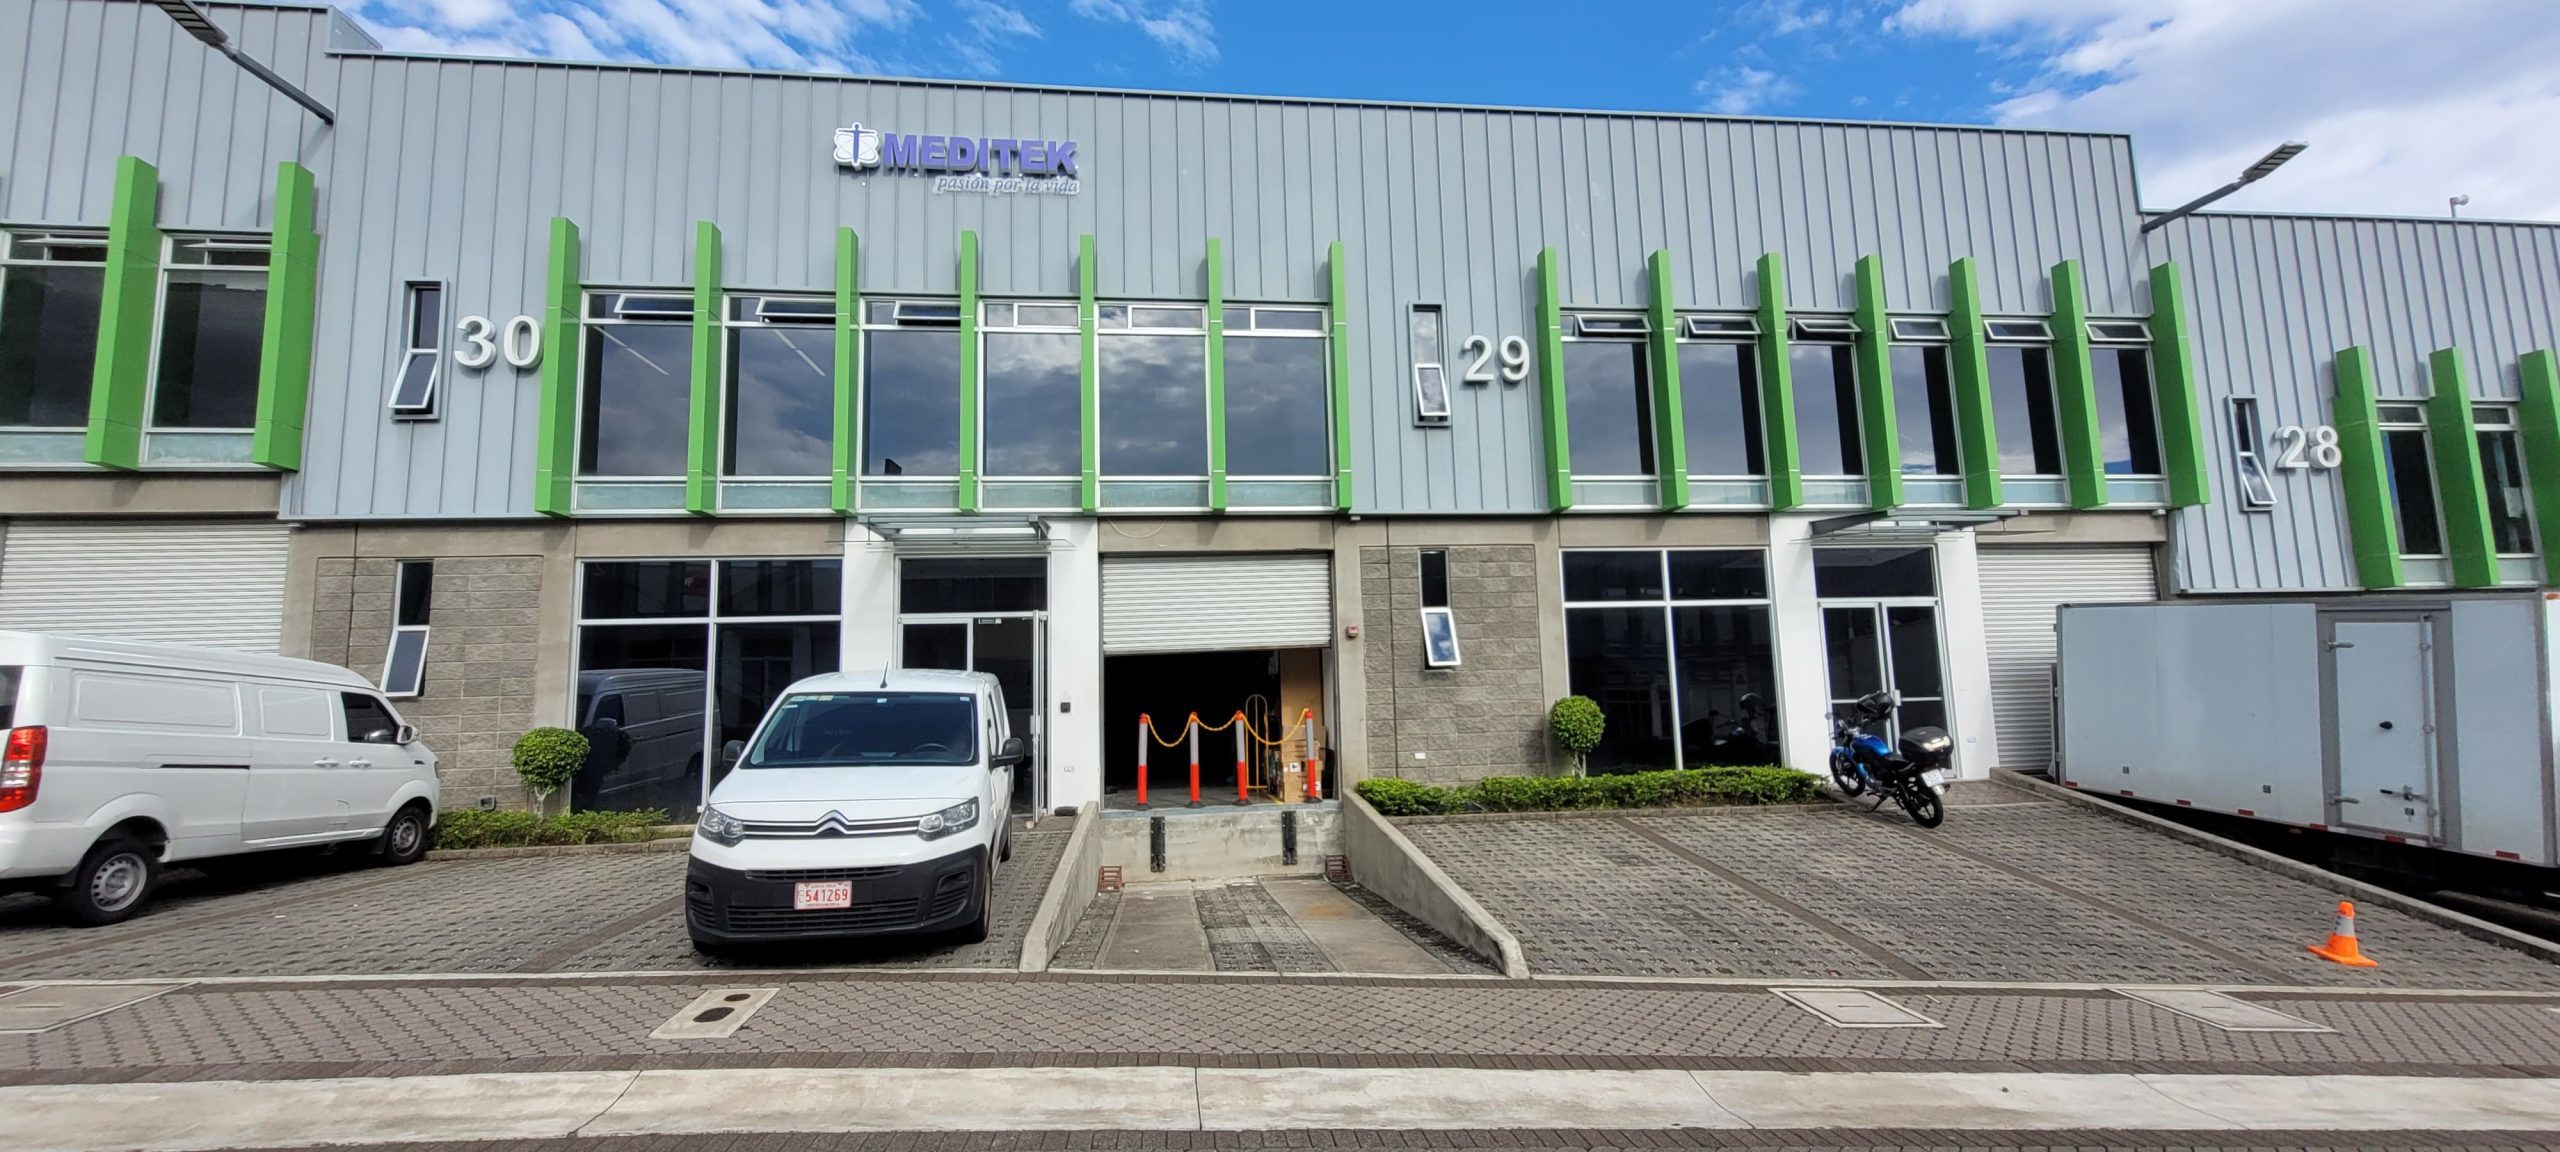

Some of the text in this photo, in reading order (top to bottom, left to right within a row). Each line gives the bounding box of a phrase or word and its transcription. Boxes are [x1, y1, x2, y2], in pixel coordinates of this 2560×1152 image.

[883, 132, 1078, 175] MEDITEK
[936, 174, 1079, 194] pasión por la vida
[454, 315, 543, 369] 30
[1463, 334, 1530, 381] 29
[2275, 425, 2342, 469] 28
[805, 888, 848, 902] 541269
